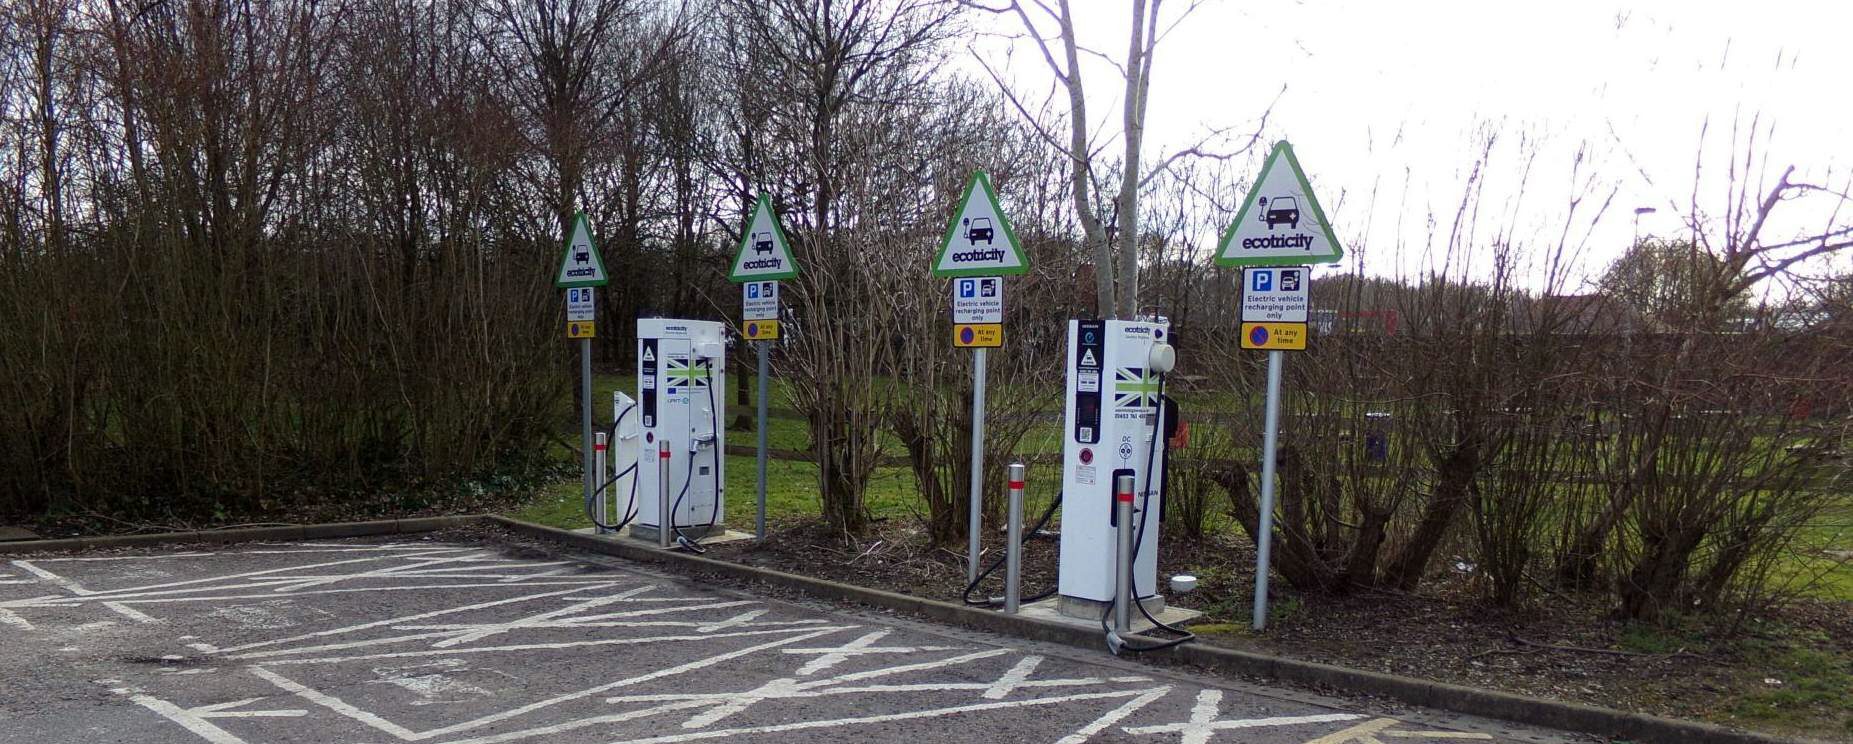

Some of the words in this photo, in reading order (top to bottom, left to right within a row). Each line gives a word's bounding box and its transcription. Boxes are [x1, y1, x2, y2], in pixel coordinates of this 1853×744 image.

[1242, 234, 1313, 250] ecotricity
[952, 249, 1005, 263] ecotricity
[743, 258, 781, 269] ecotricity
[567, 267, 596, 278] ecotricity
[1257, 273, 1268, 290] P
[750, 286, 756, 297] P
[963, 282, 972, 296] P
[986, 307, 1000, 315] point
[1245, 303, 1284, 311] recharging
[1286, 303, 1306, 311] point
[1266, 311, 1282, 319] only
[1137, 489, 1159, 498] NIAN
